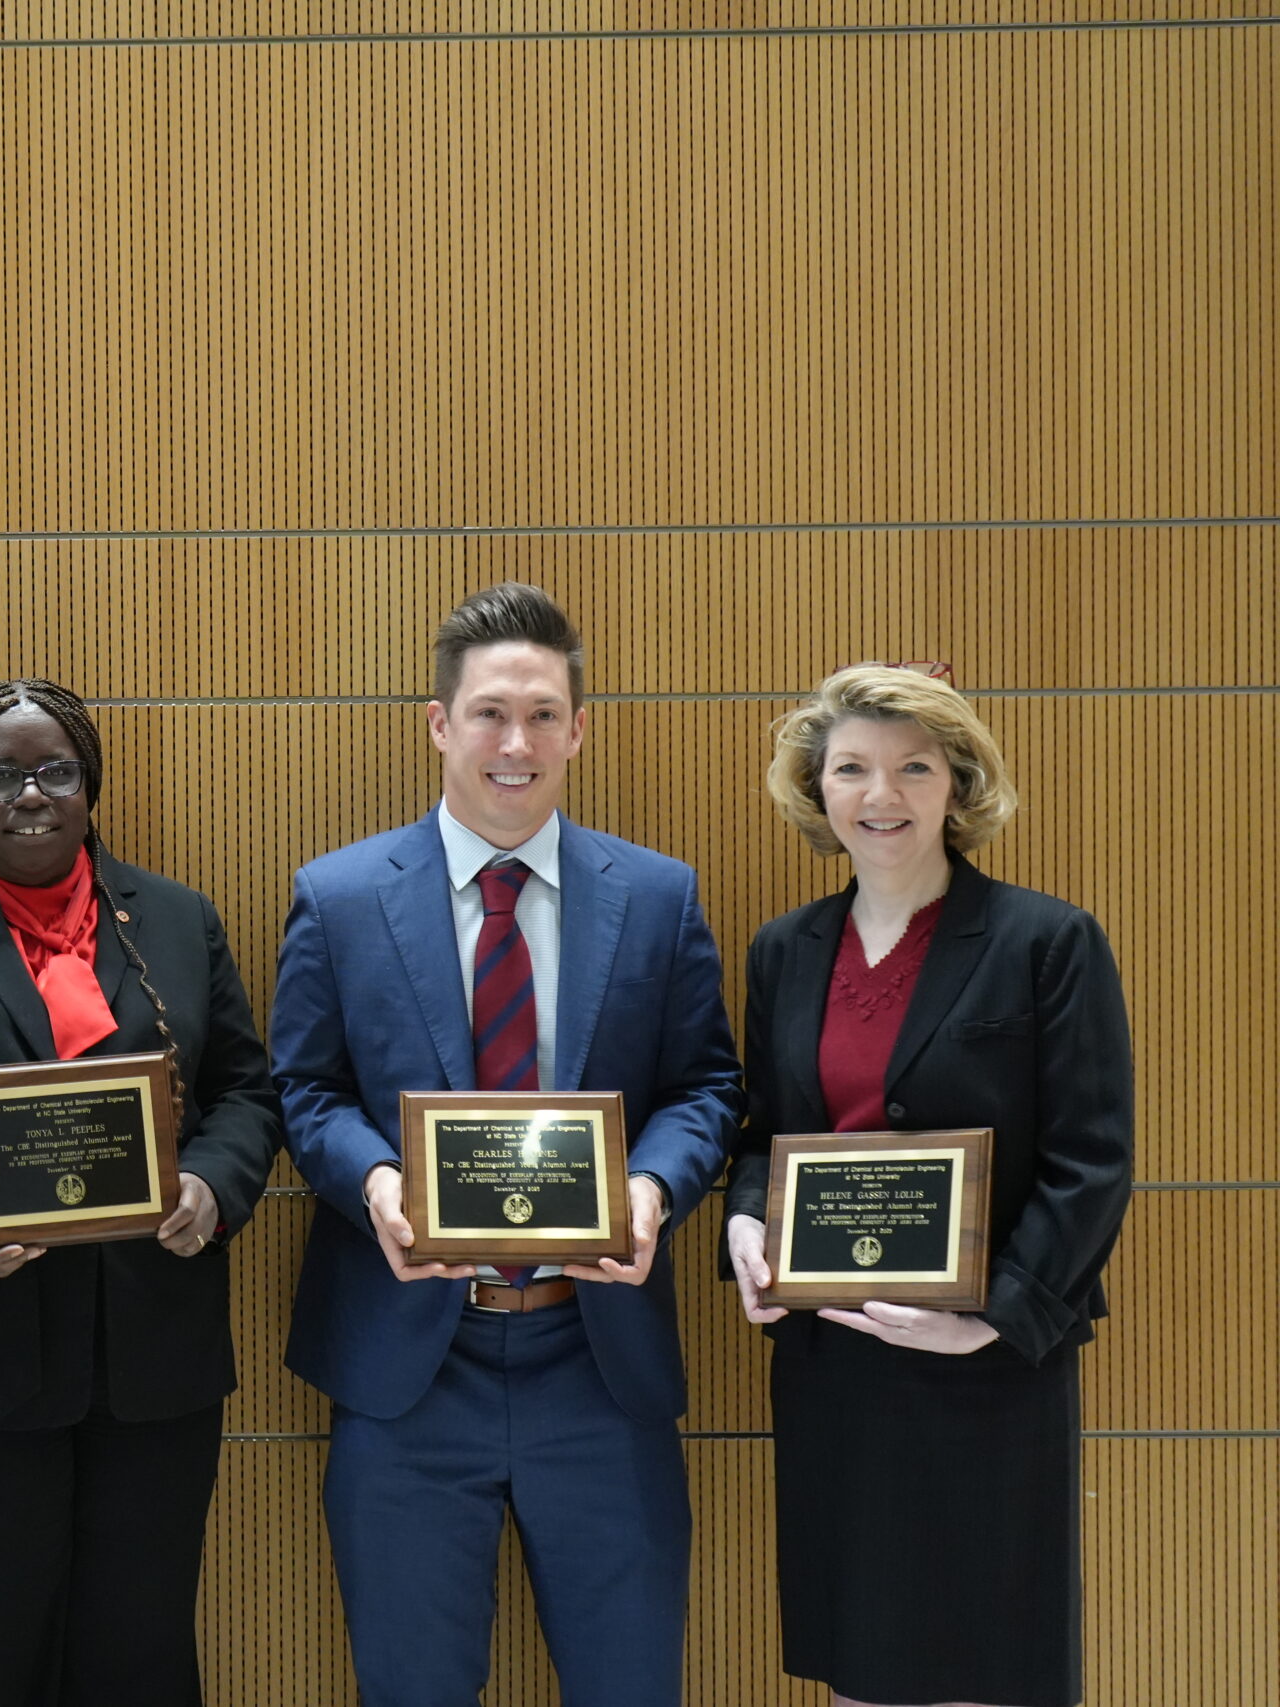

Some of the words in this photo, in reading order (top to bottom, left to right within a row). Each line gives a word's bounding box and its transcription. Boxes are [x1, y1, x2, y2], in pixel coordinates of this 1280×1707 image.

[3, 1104, 30, 1112] Department
[25, 1129, 53, 1138] TONYA
[71, 1124, 105, 1134] PEEPLES
[35, 1138, 78, 1149] Distinguished
[472, 1150, 513, 1158] CHARLES
[474, 1161, 516, 1169] Distinguished
[820, 1191, 852, 1199] HELENE
[895, 1191, 924, 1199] LOLLIS
